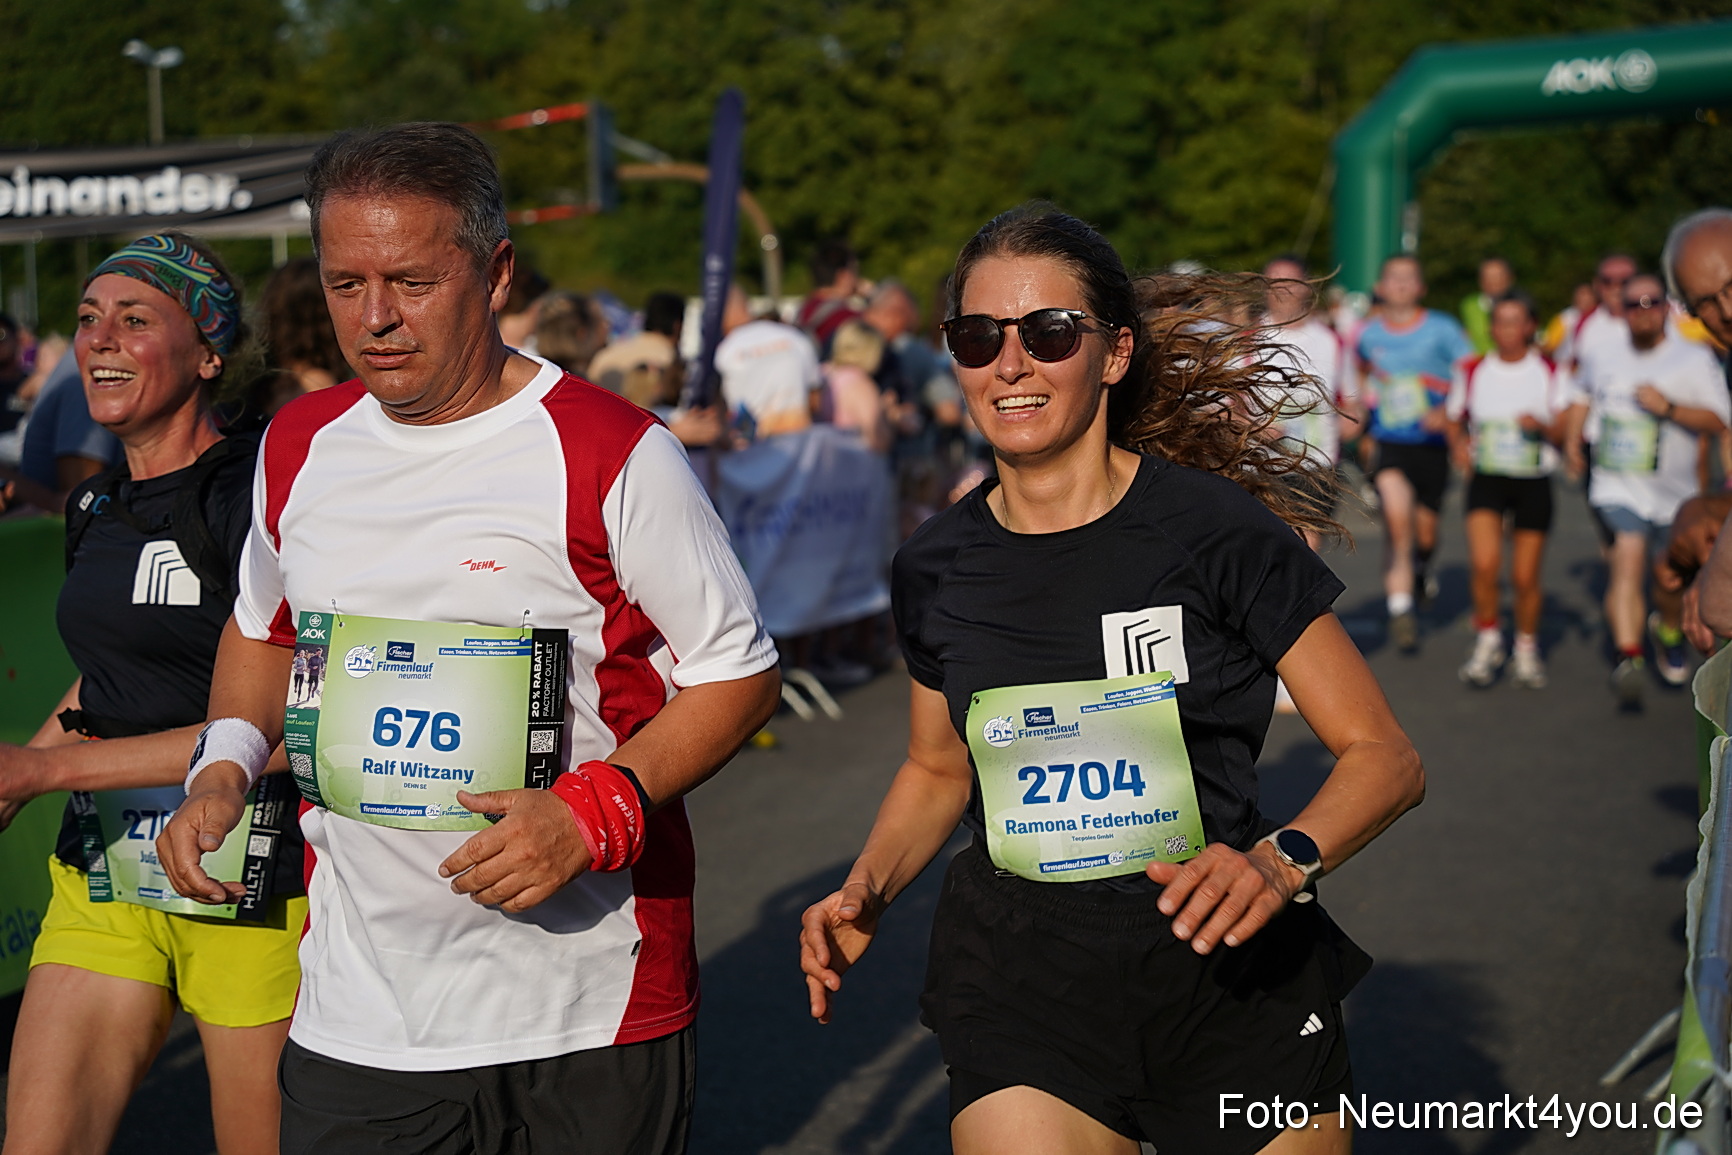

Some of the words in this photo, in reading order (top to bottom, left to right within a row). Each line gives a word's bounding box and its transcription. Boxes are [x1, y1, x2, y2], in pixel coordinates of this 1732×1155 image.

[1541, 56, 1618, 97] AOK
[469, 560, 496, 571] DEHN
[300, 628, 326, 640] AOK
[376, 661, 434, 673] Firmenlauf
[533, 641, 543, 689] RABATT
[544, 642, 553, 677] OUTLET
[398, 672, 432, 680] neumarkt
[532, 691, 541, 699] %
[543, 678, 552, 717] FACTORY
[531, 701, 540, 718] 20
[372, 706, 461, 752] 676
[1018, 721, 1079, 739] Firmenlauf
[1044, 731, 1080, 742] neumarkt
[362, 757, 397, 776] Ralf
[400, 761, 475, 784] Witzany
[1017, 759, 1146, 806] 2704
[253, 811, 261, 825] 20
[363, 805, 423, 817] firmenlauf.bayern
[1005, 819, 1077, 835] Ramona
[1081, 808, 1179, 830] Federhofer
[1042, 857, 1106, 873] firmenlauf.bayern
[243, 860, 262, 909] HILTL
